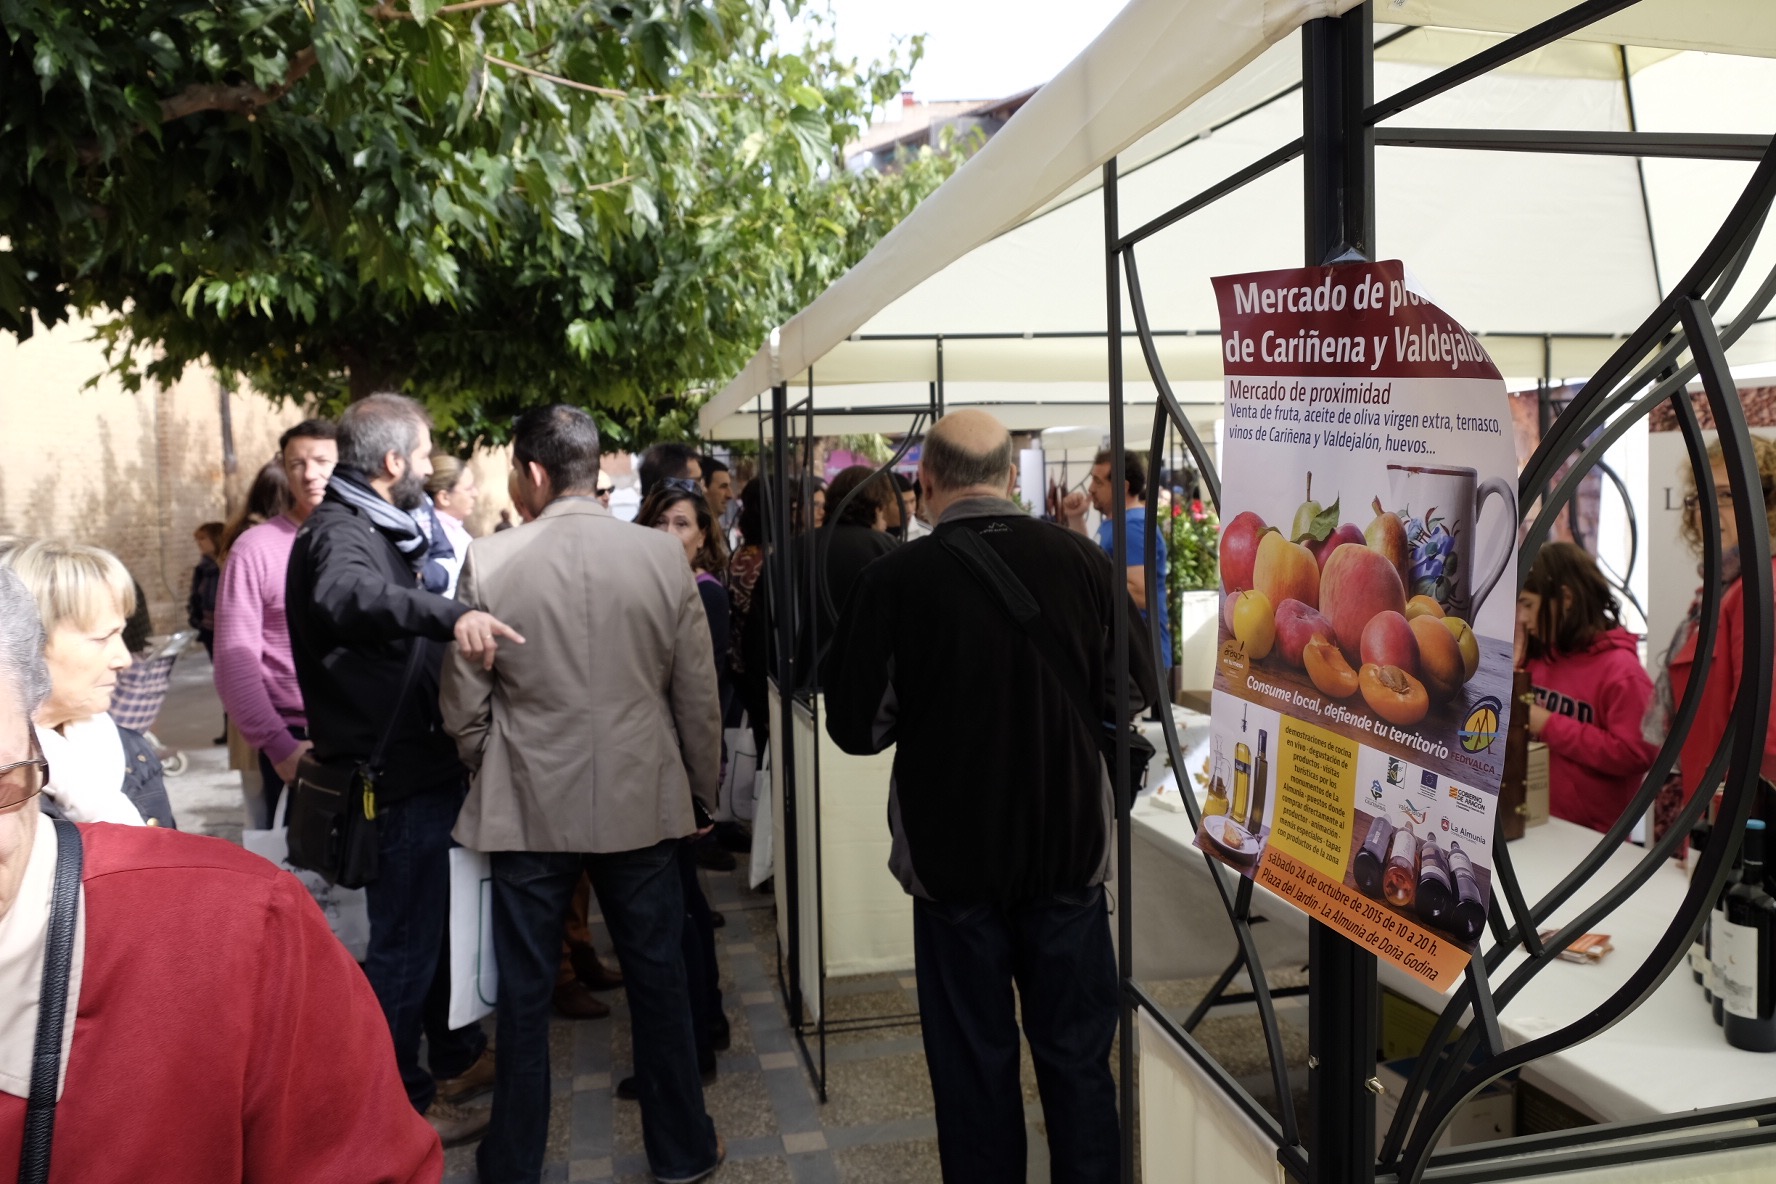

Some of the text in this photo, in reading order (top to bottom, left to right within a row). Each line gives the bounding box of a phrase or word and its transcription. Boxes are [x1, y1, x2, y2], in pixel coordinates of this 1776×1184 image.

[1233, 276, 1347, 315] Mercado
[1353, 273, 1384, 310] de
[1225, 330, 1255, 363] de
[1261, 328, 1366, 363] Cariñena
[1370, 335, 1388, 371] y
[1229, 380, 1391, 406] Mercado de proximidad
[1230, 403, 1502, 436] Venta de fruta, aceite de oliva virgen extra, ternasco,
[1229, 424, 1436, 455] vinos de Cariñena y Valdejalón, huevos...
[1246, 675, 1449, 760] Consume local, defiende tu territorio
[1285, 725, 1352, 759] demostraciones de cocina
[1286, 739, 1294, 747] en
[1294, 741, 1306, 752] vivo
[1341, 760, 1349, 769] de
[1293, 753, 1340, 778] productos visitas
[1450, 751, 1496, 775] FEDIVALCA
[1283, 782, 1346, 817] Almunia puestos donde
[1290, 775, 1325, 796] monumentos
[1325, 789, 1333, 799] de
[1457, 789, 1483, 804] GOBIERNO
[1303, 803, 1339, 827] directamente
[1277, 828, 1340, 866] con productos de la zona
[1325, 839, 1342, 853] tapas
[1450, 822, 1459, 832] La
[1459, 827, 1486, 845] Almunia
[1267, 852, 1437, 957] sábado 24 de octubre de 2015 de 10 a 20 h.
[1261, 867, 1439, 981] Plaza del Jardín La Almunia de Doña Godina
